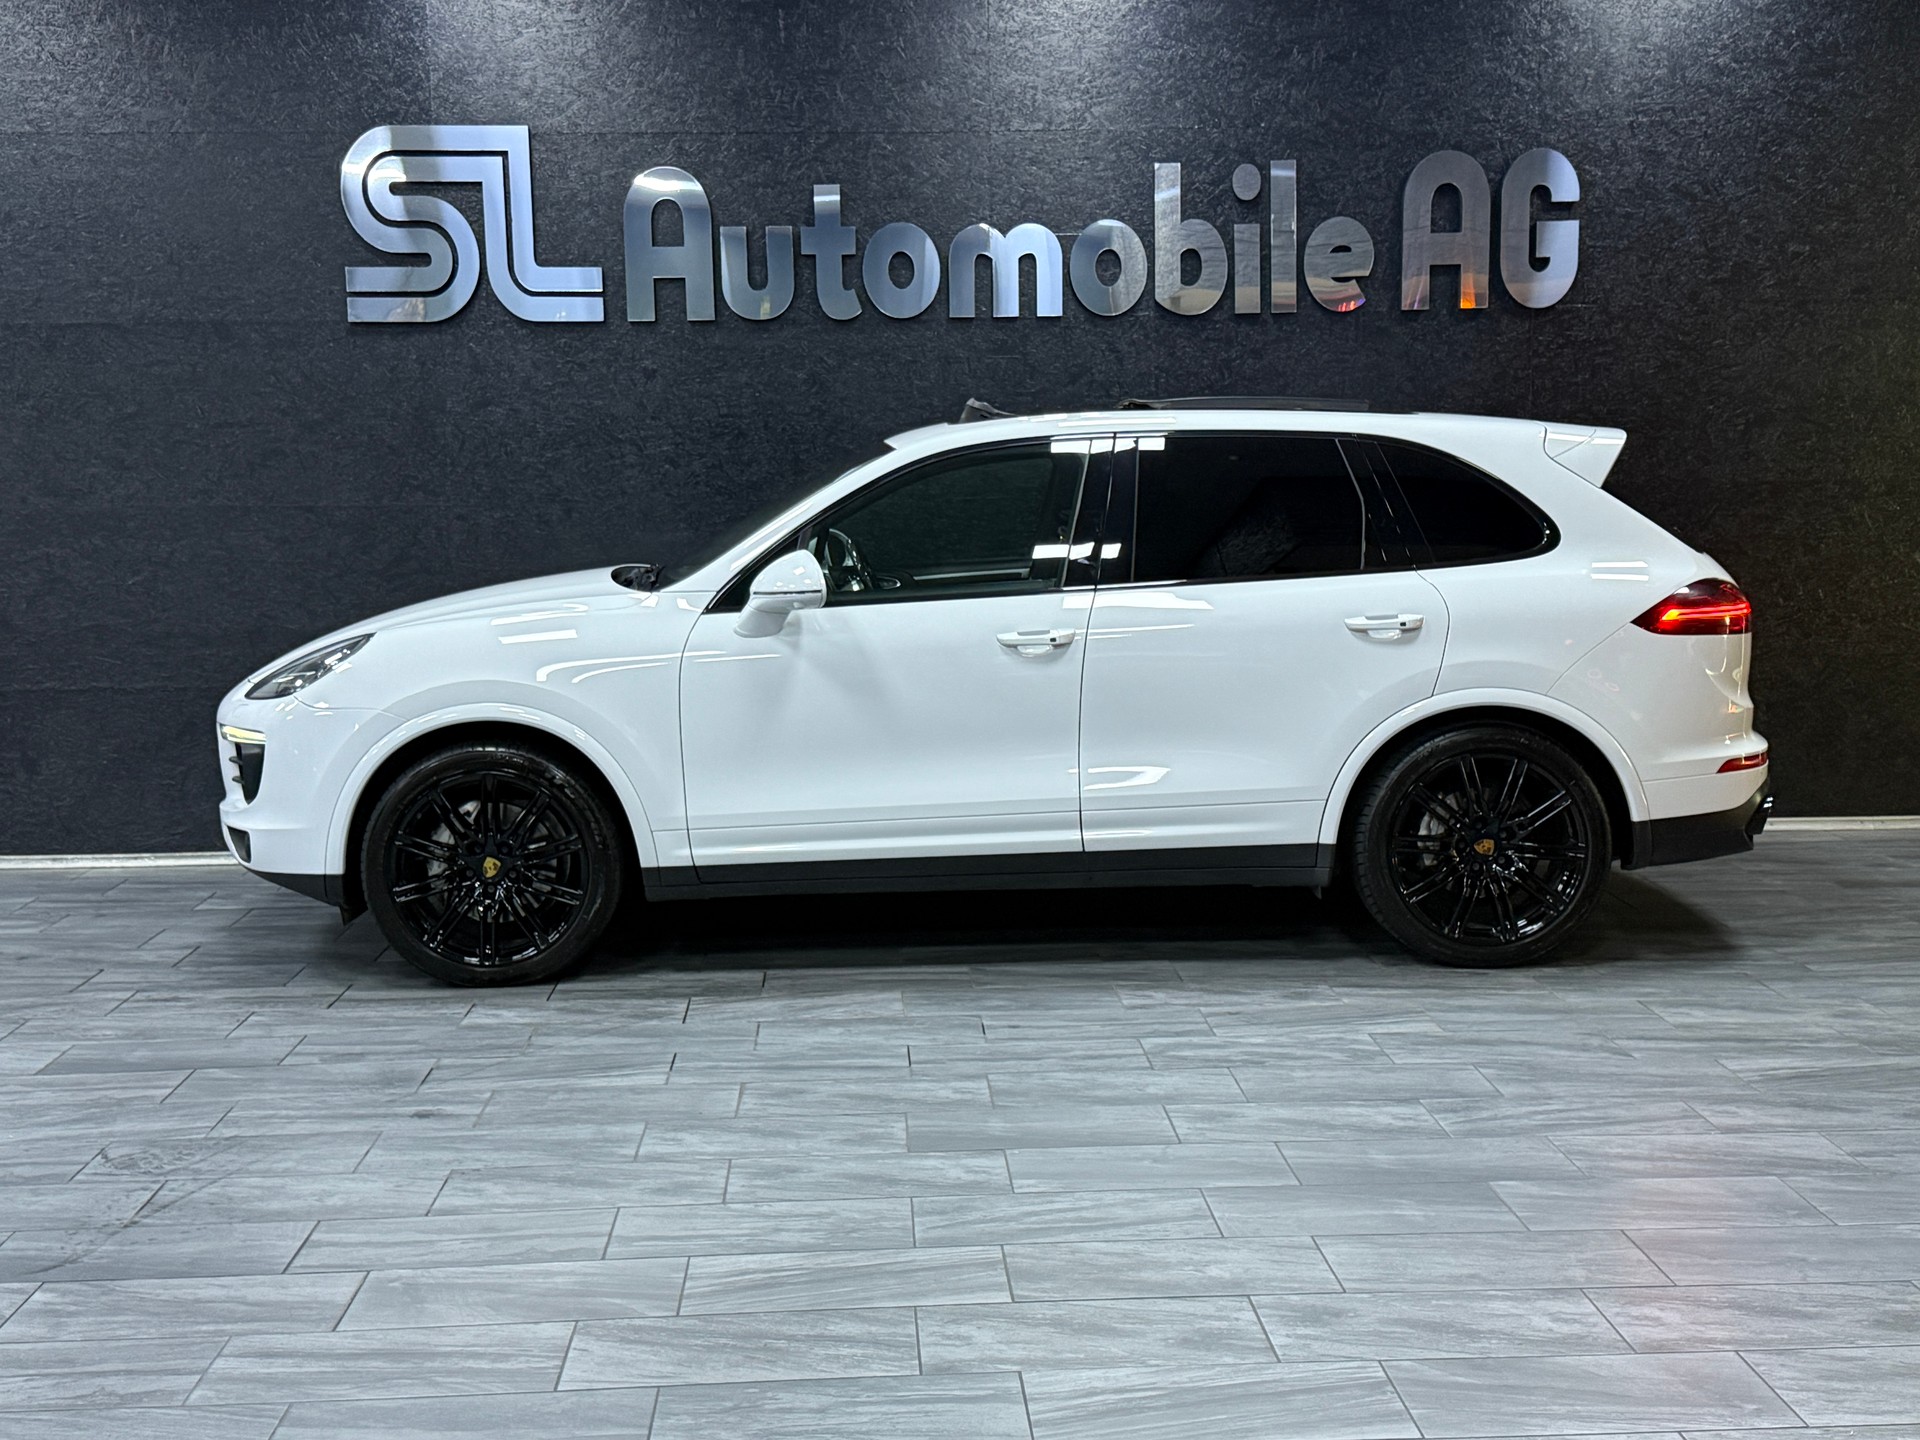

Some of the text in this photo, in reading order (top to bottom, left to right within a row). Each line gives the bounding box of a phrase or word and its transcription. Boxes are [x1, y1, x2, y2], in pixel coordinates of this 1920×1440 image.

[341, 125, 1580, 322] SL Automobile AG
